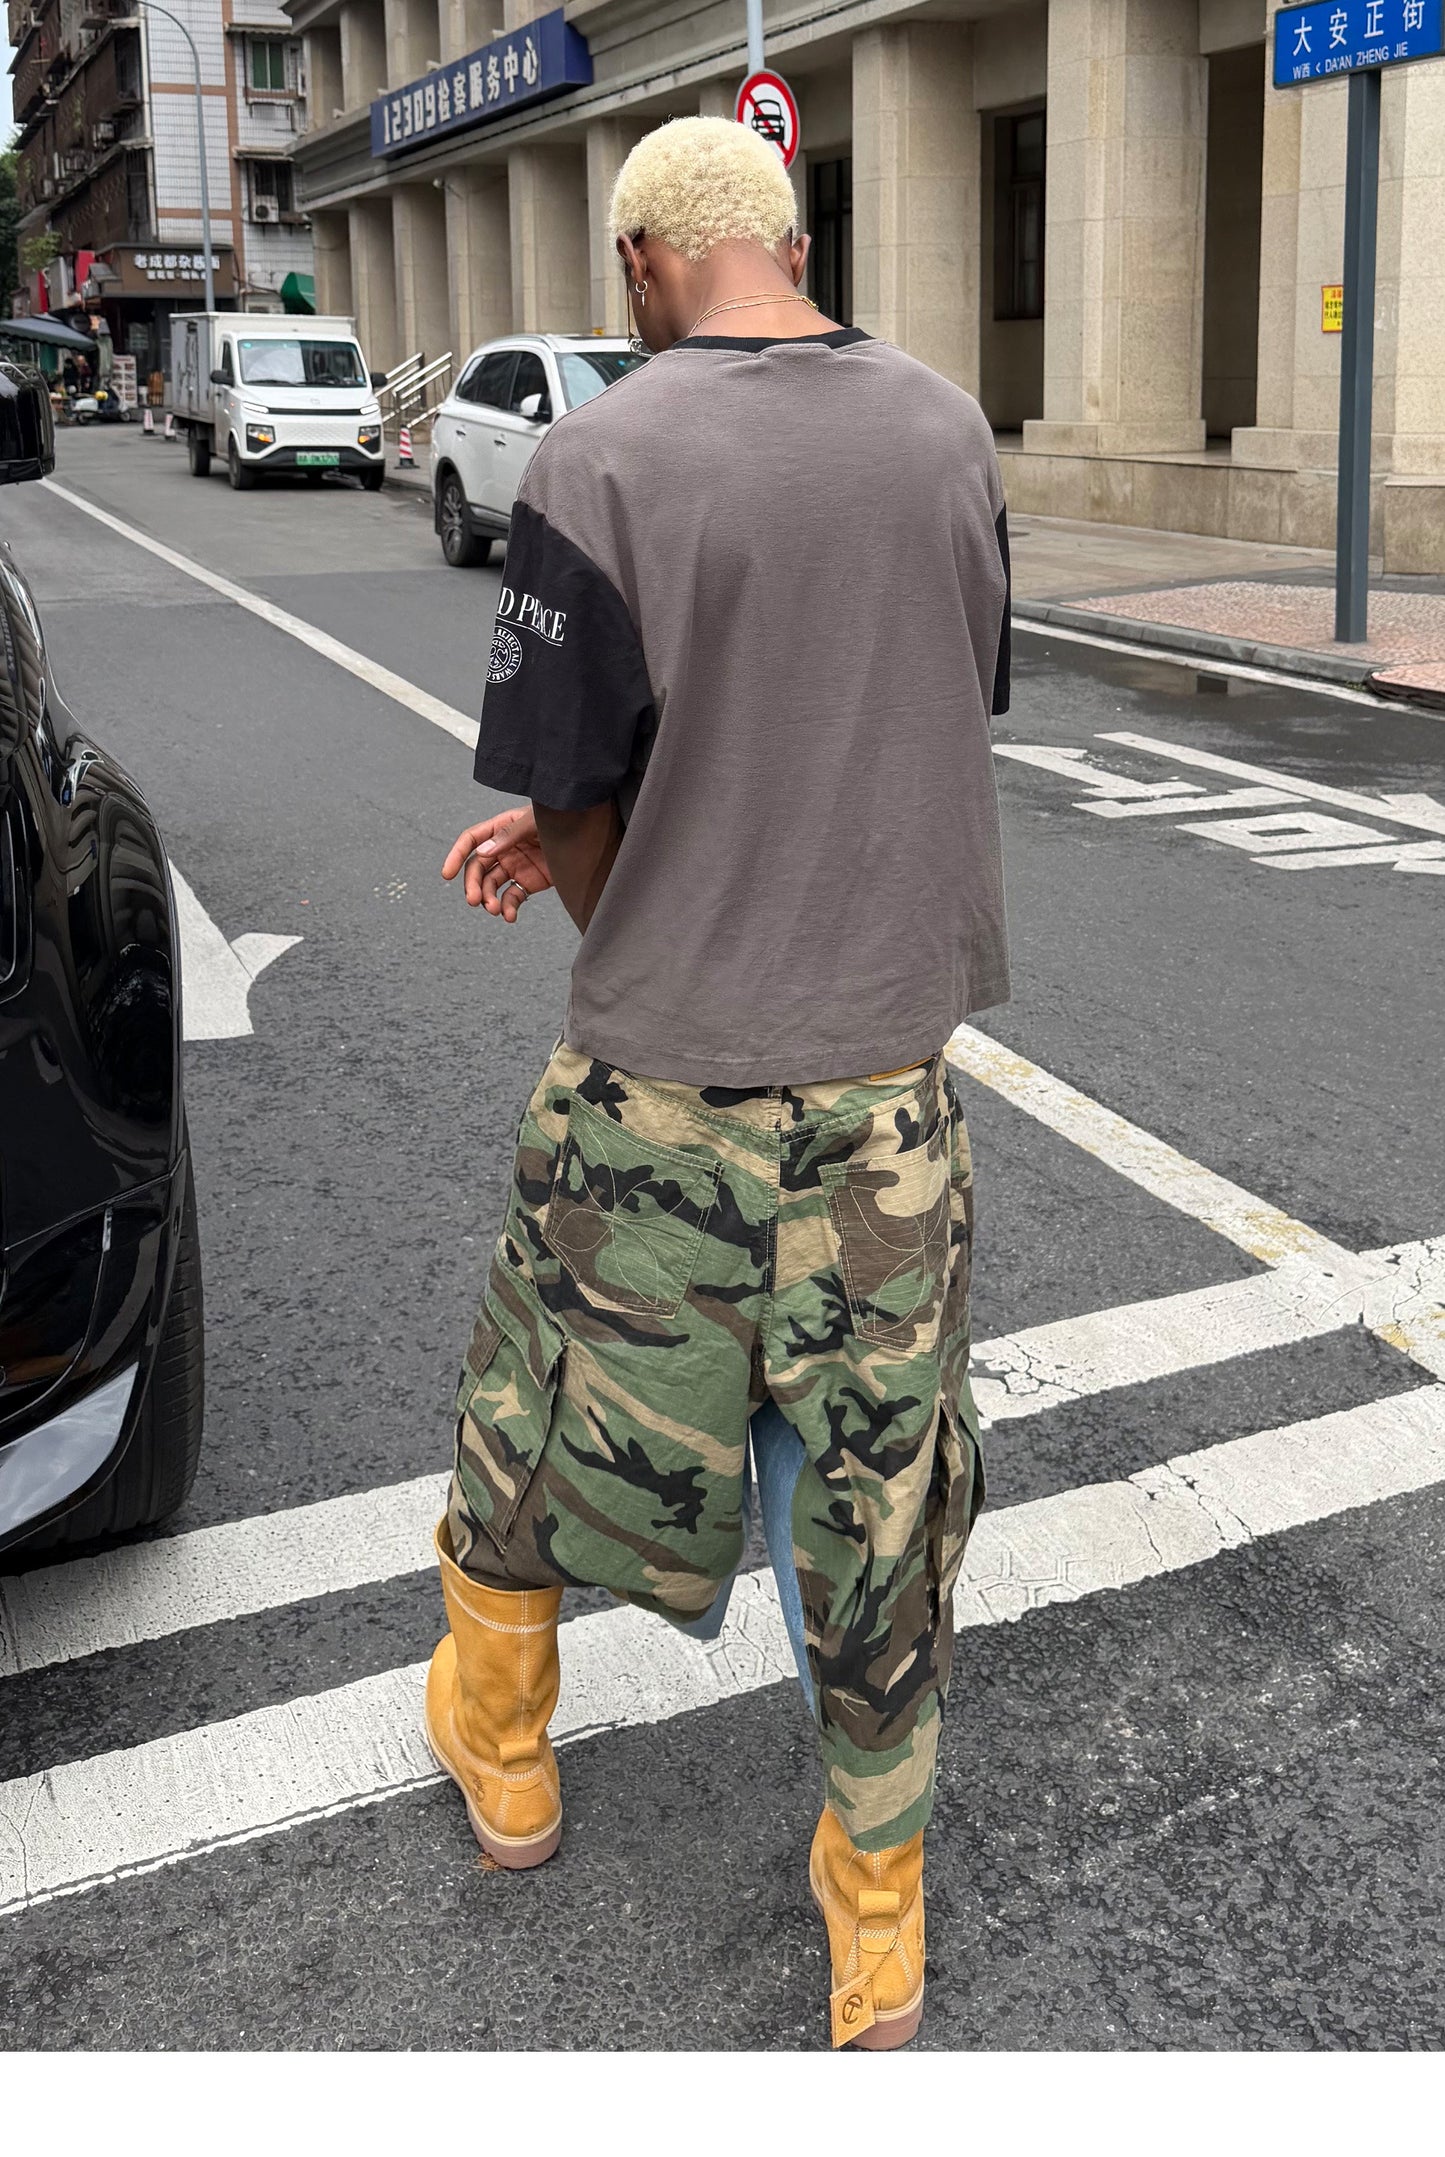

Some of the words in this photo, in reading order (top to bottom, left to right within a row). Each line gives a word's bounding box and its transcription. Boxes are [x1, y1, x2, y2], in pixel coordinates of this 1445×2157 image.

[1293, 0, 1424, 56] 大安正街
[1356, 45, 1389, 67] ZHENG
[1393, 41, 1409, 58] JIE
[383, 36, 538, 145] 12309检察服务中心
